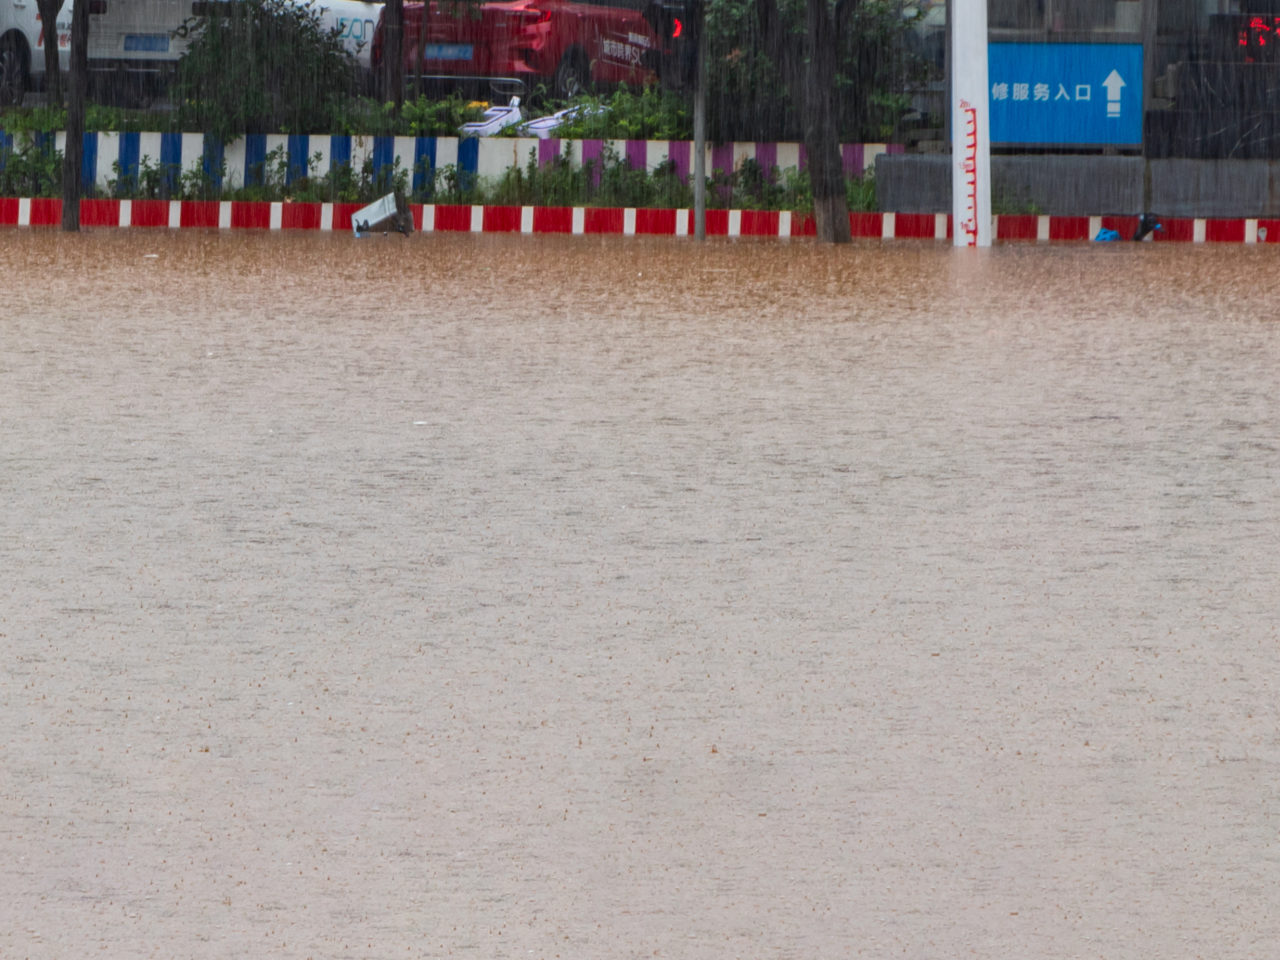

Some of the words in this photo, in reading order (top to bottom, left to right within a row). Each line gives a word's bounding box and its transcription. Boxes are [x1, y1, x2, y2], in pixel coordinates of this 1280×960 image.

[992, 82, 1091, 101] 修服务入口
